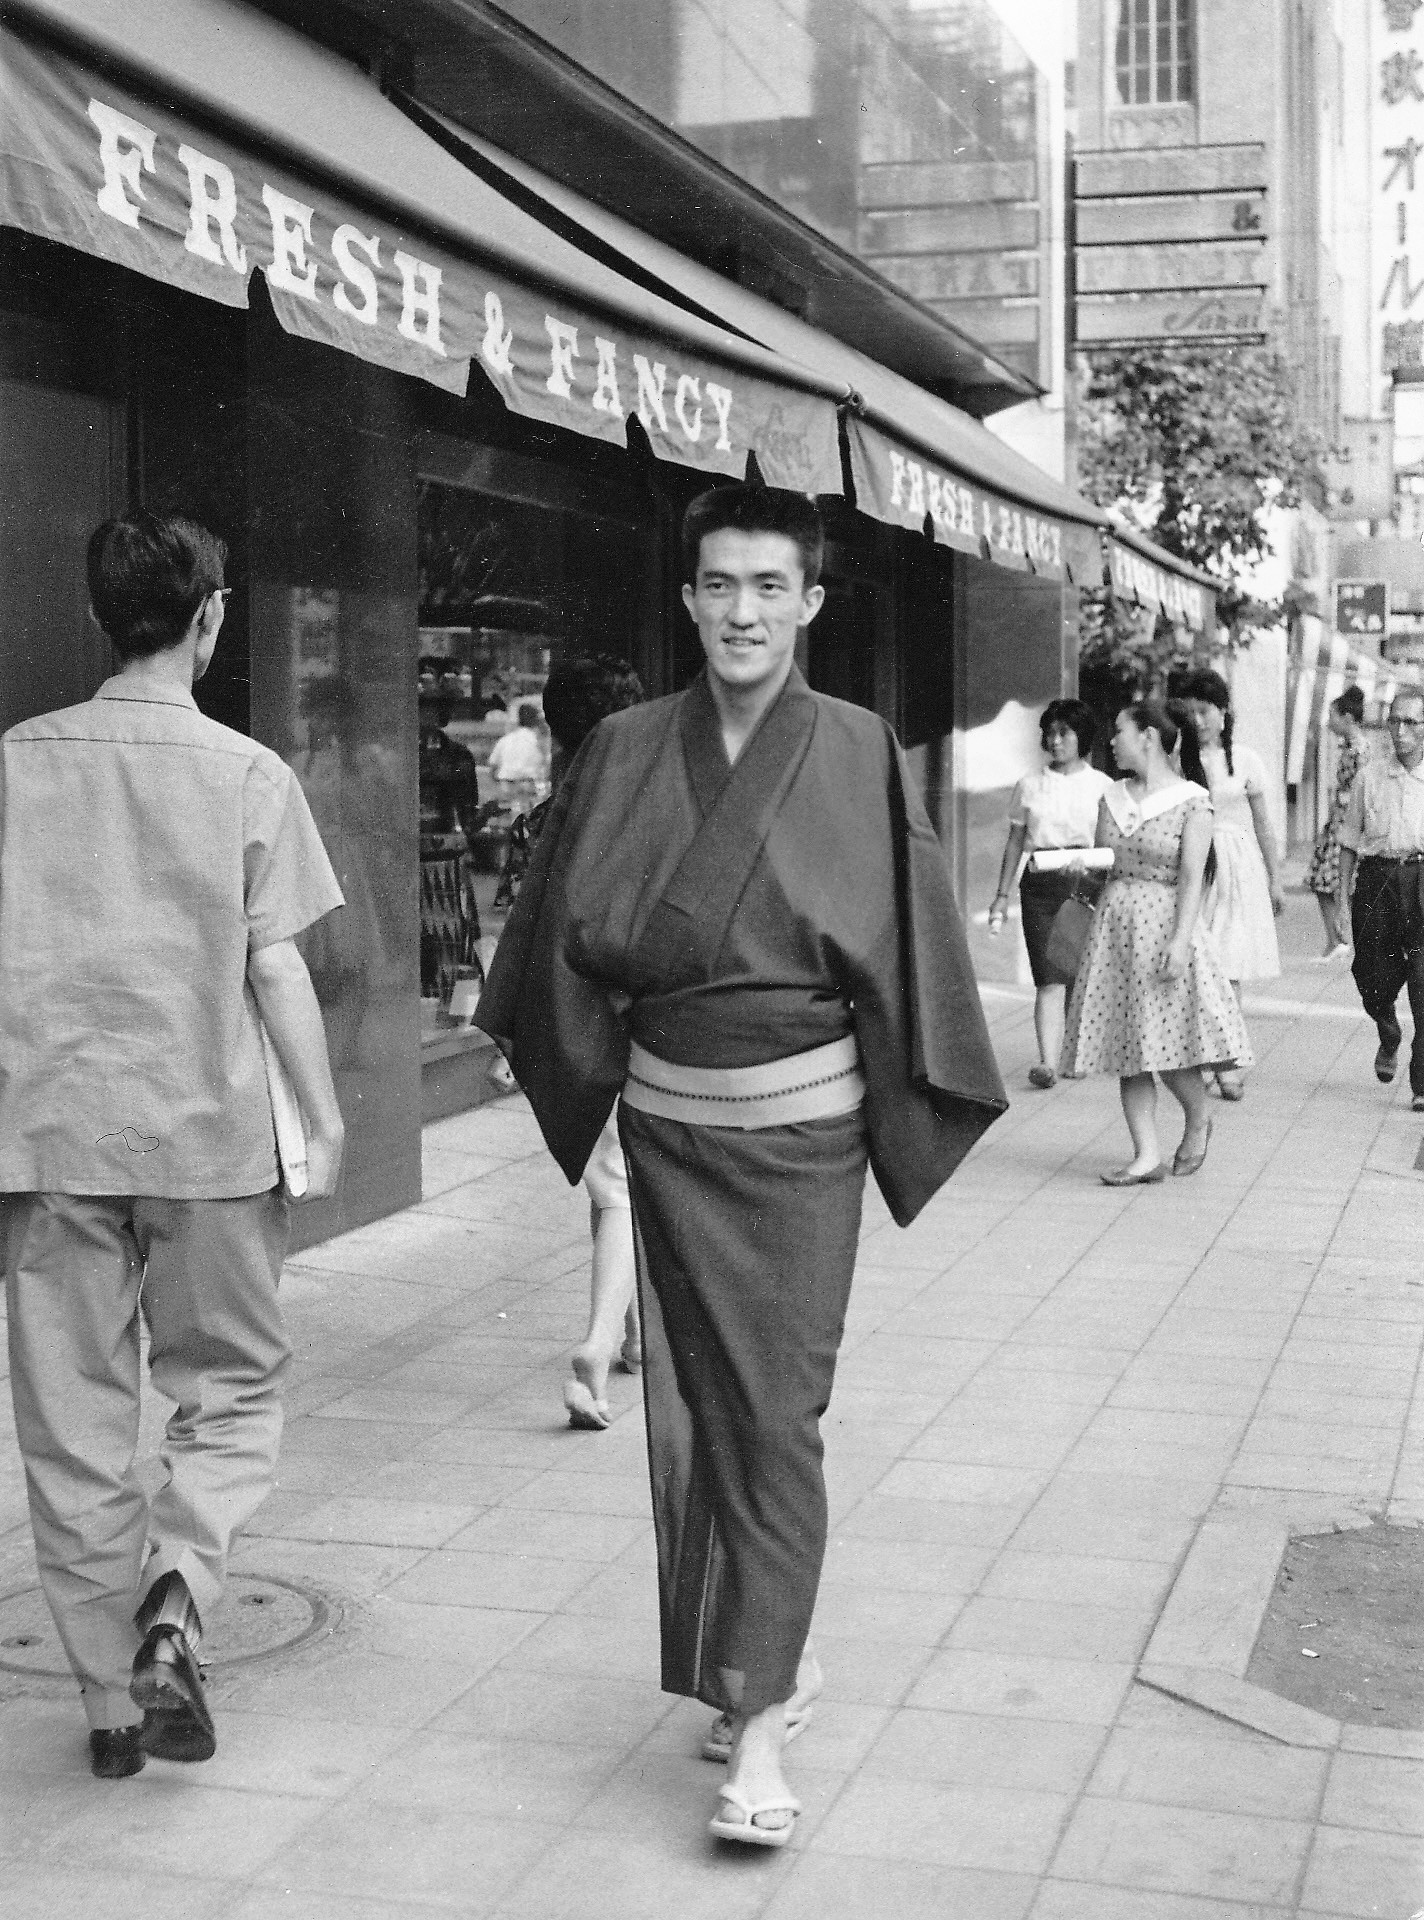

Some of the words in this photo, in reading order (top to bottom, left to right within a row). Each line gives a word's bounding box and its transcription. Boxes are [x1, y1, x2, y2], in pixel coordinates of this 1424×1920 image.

[88, 97, 448, 358] FRESH
[482, 290, 515, 376] &
[544, 313, 733, 452] FANCY
[888, 449, 976, 536] FRESH
